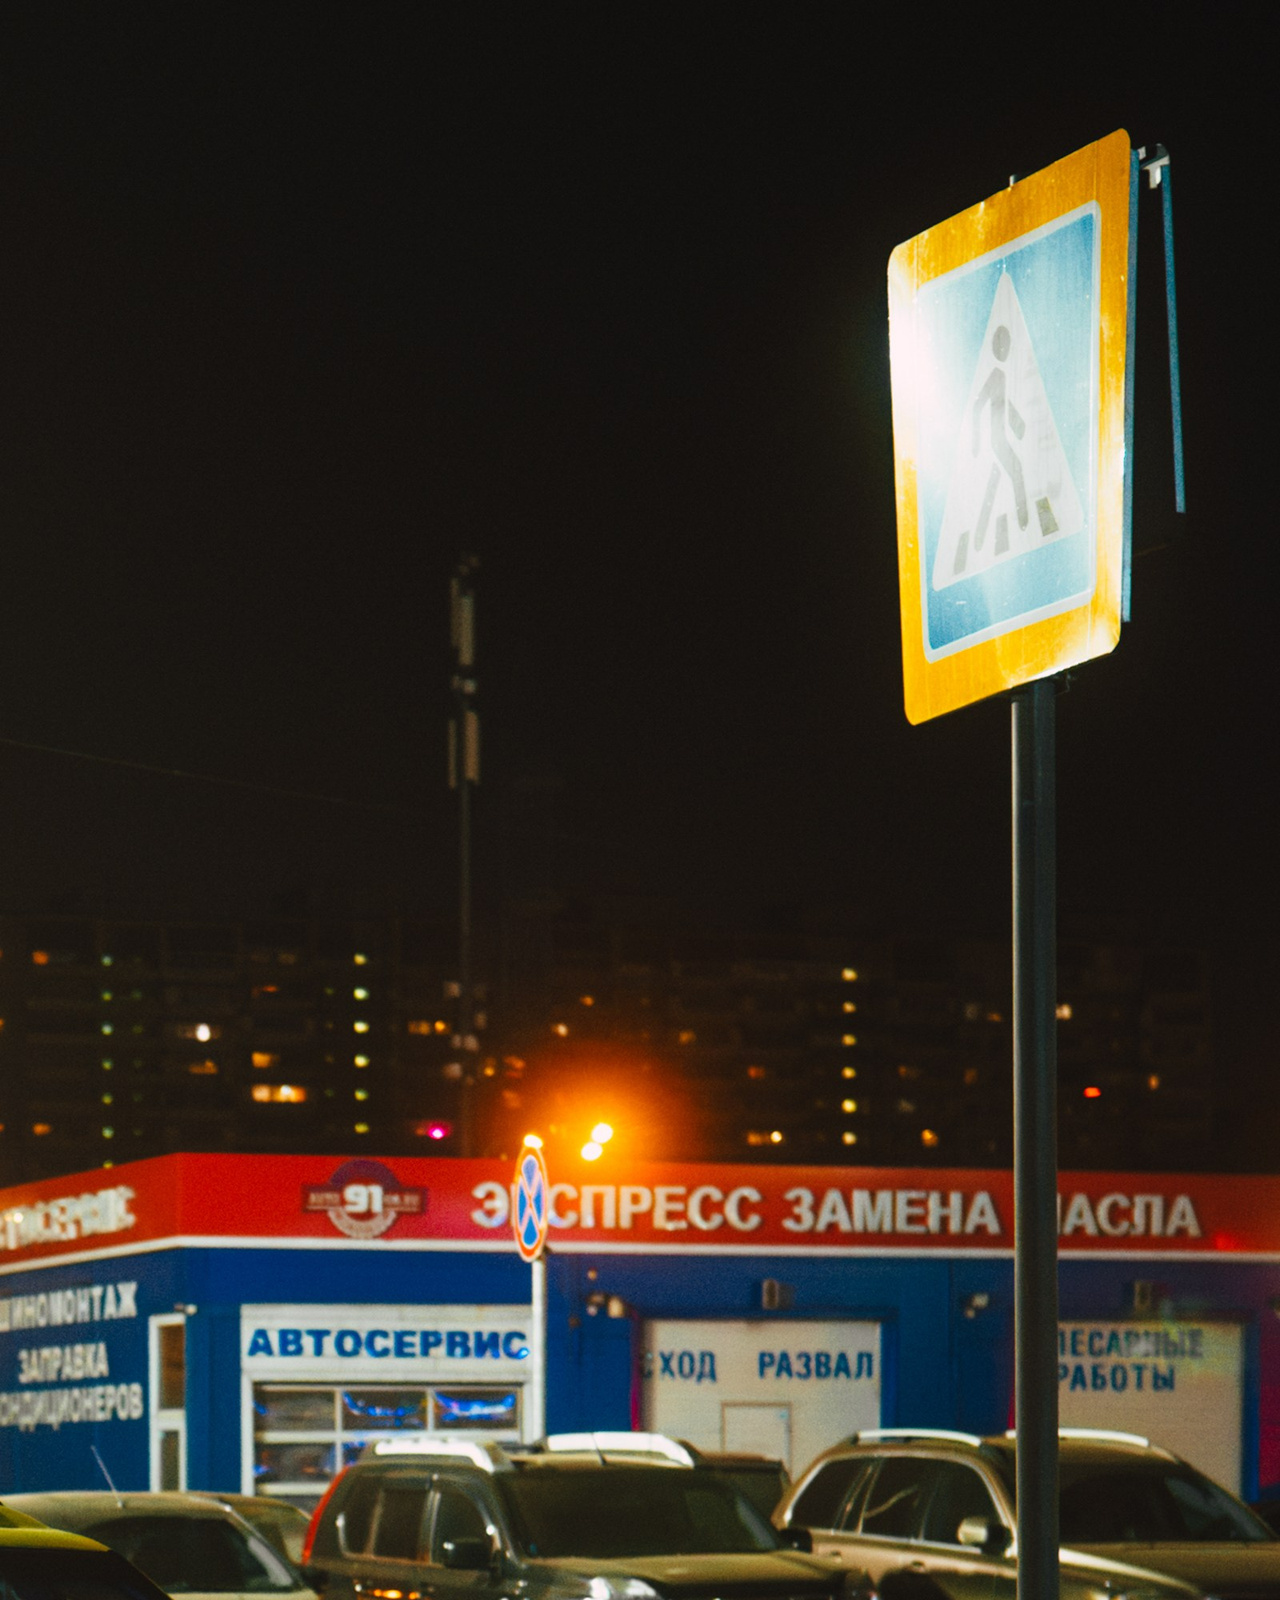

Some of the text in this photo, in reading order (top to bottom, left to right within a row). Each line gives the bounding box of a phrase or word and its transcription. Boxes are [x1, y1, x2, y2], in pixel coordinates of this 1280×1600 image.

[344, 1183, 384, 1214] 91
[471, 1181, 1202, 1238] ЭСПРЕСС ЗАМЕНА АСЛА
[247, 1328, 530, 1360] АВТОСЕРВИС
[18, 1342, 109, 1384] ЗАПРАВКА
[758, 1351, 874, 1381] РАЗВАЛ
